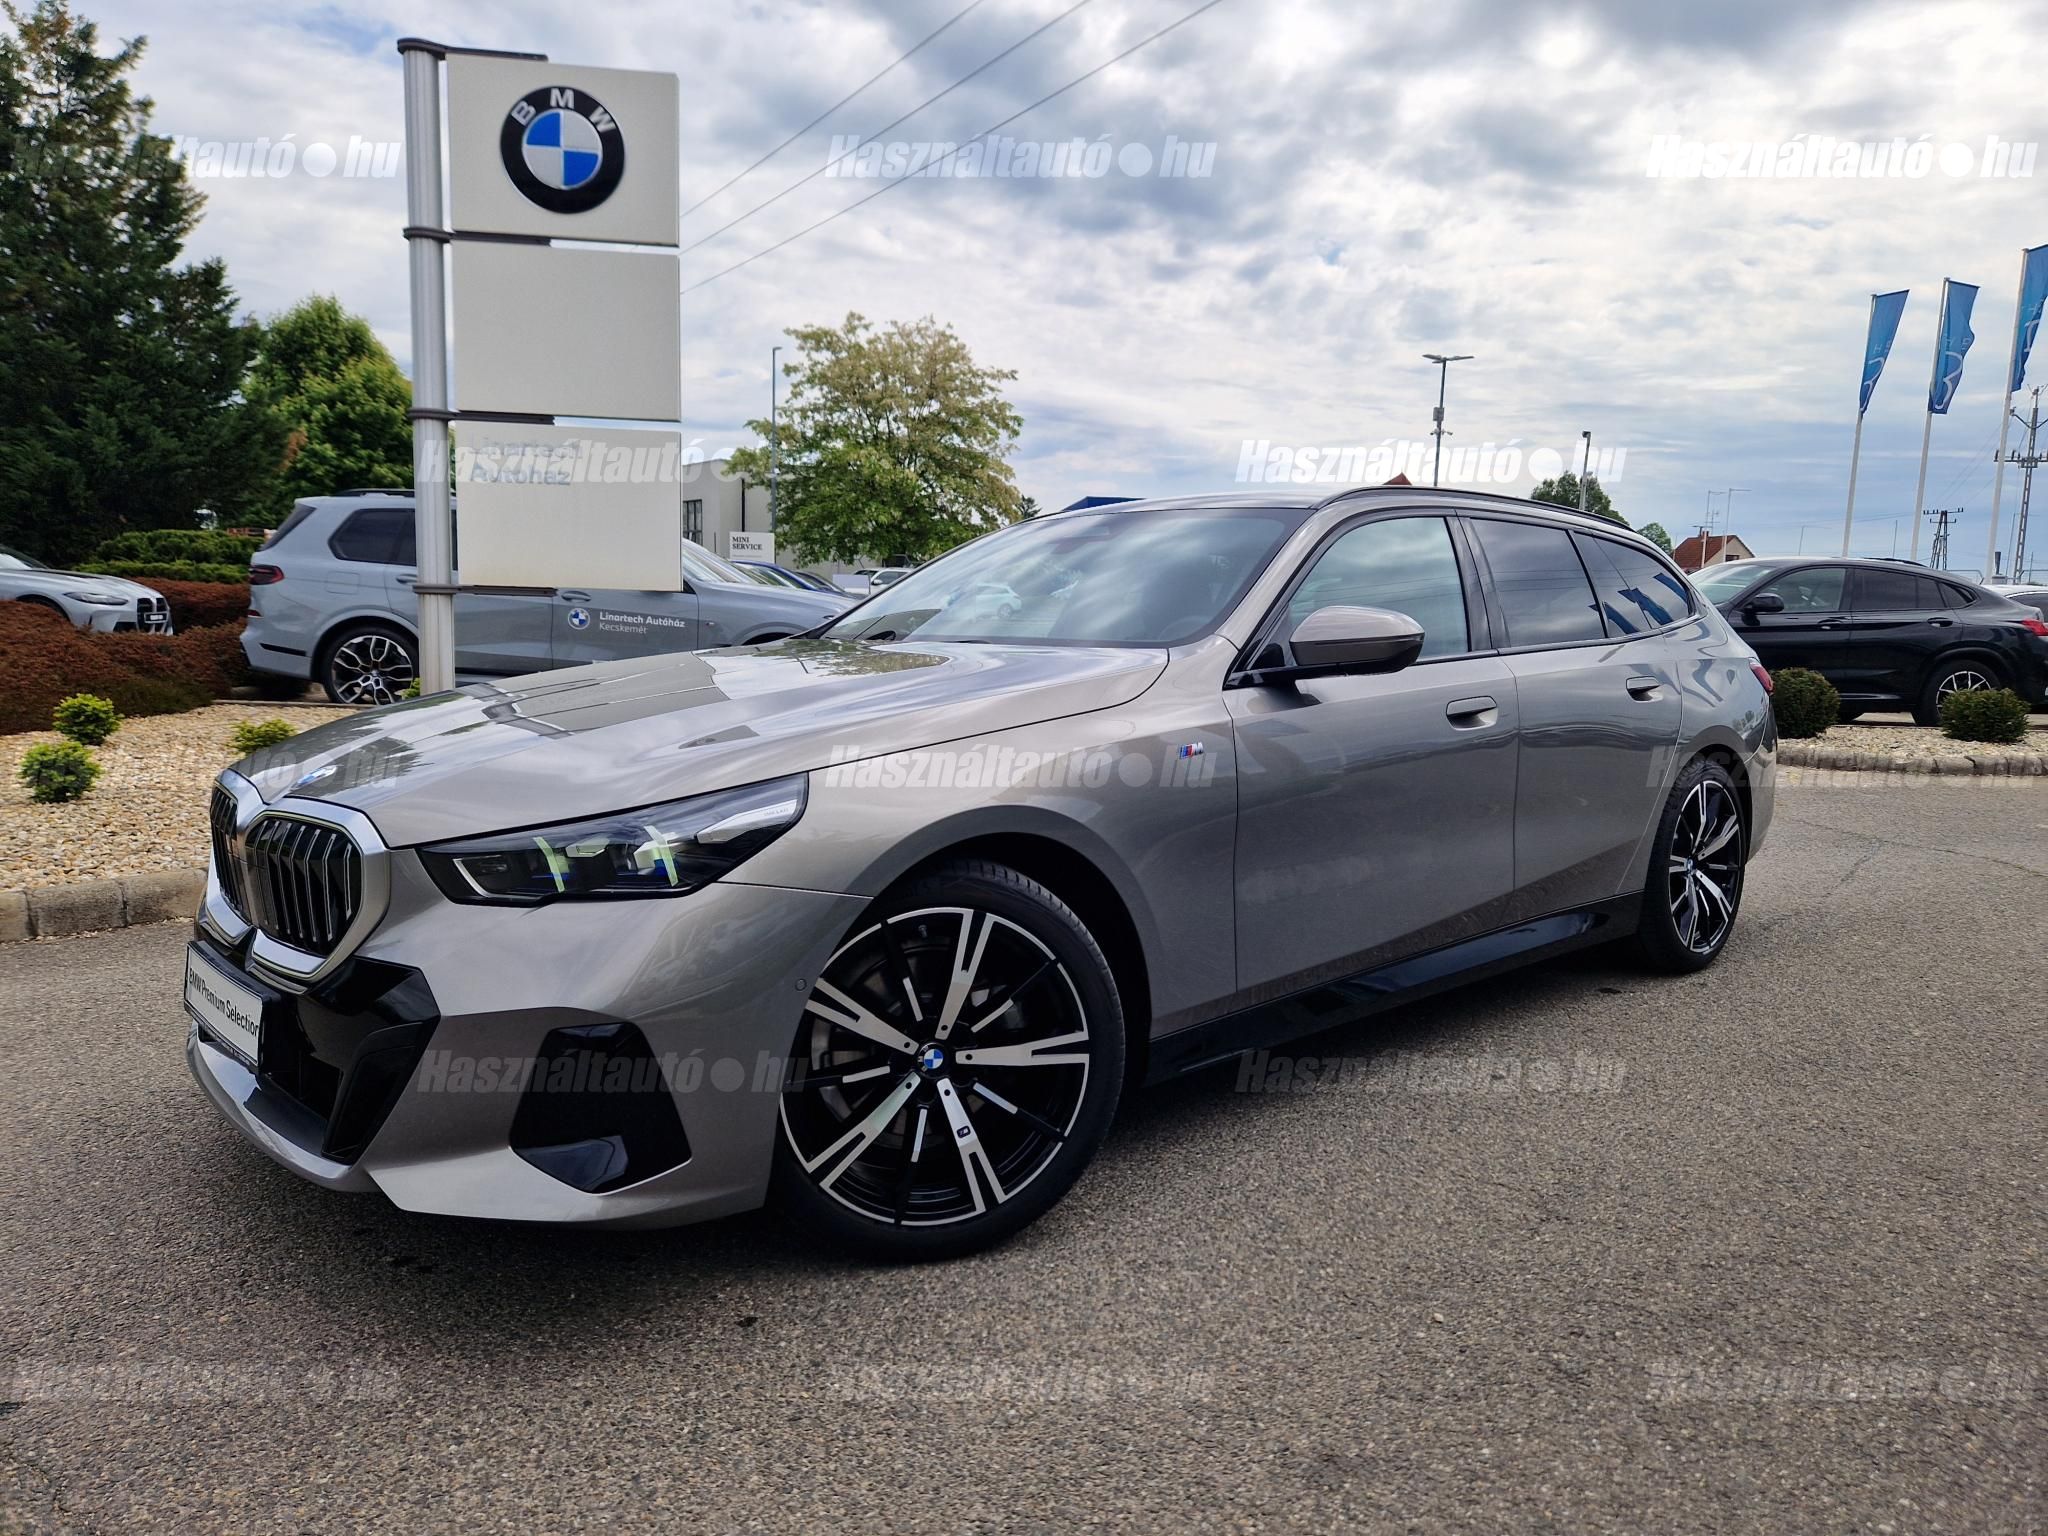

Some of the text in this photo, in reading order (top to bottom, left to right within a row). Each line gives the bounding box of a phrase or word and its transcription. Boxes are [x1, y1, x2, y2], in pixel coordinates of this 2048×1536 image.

[511, 87, 616, 133] BMW
[599, 611, 644, 624] Linartech
[599, 623, 649, 634] Kecskemét
[201, 981, 226, 1014] Premium
